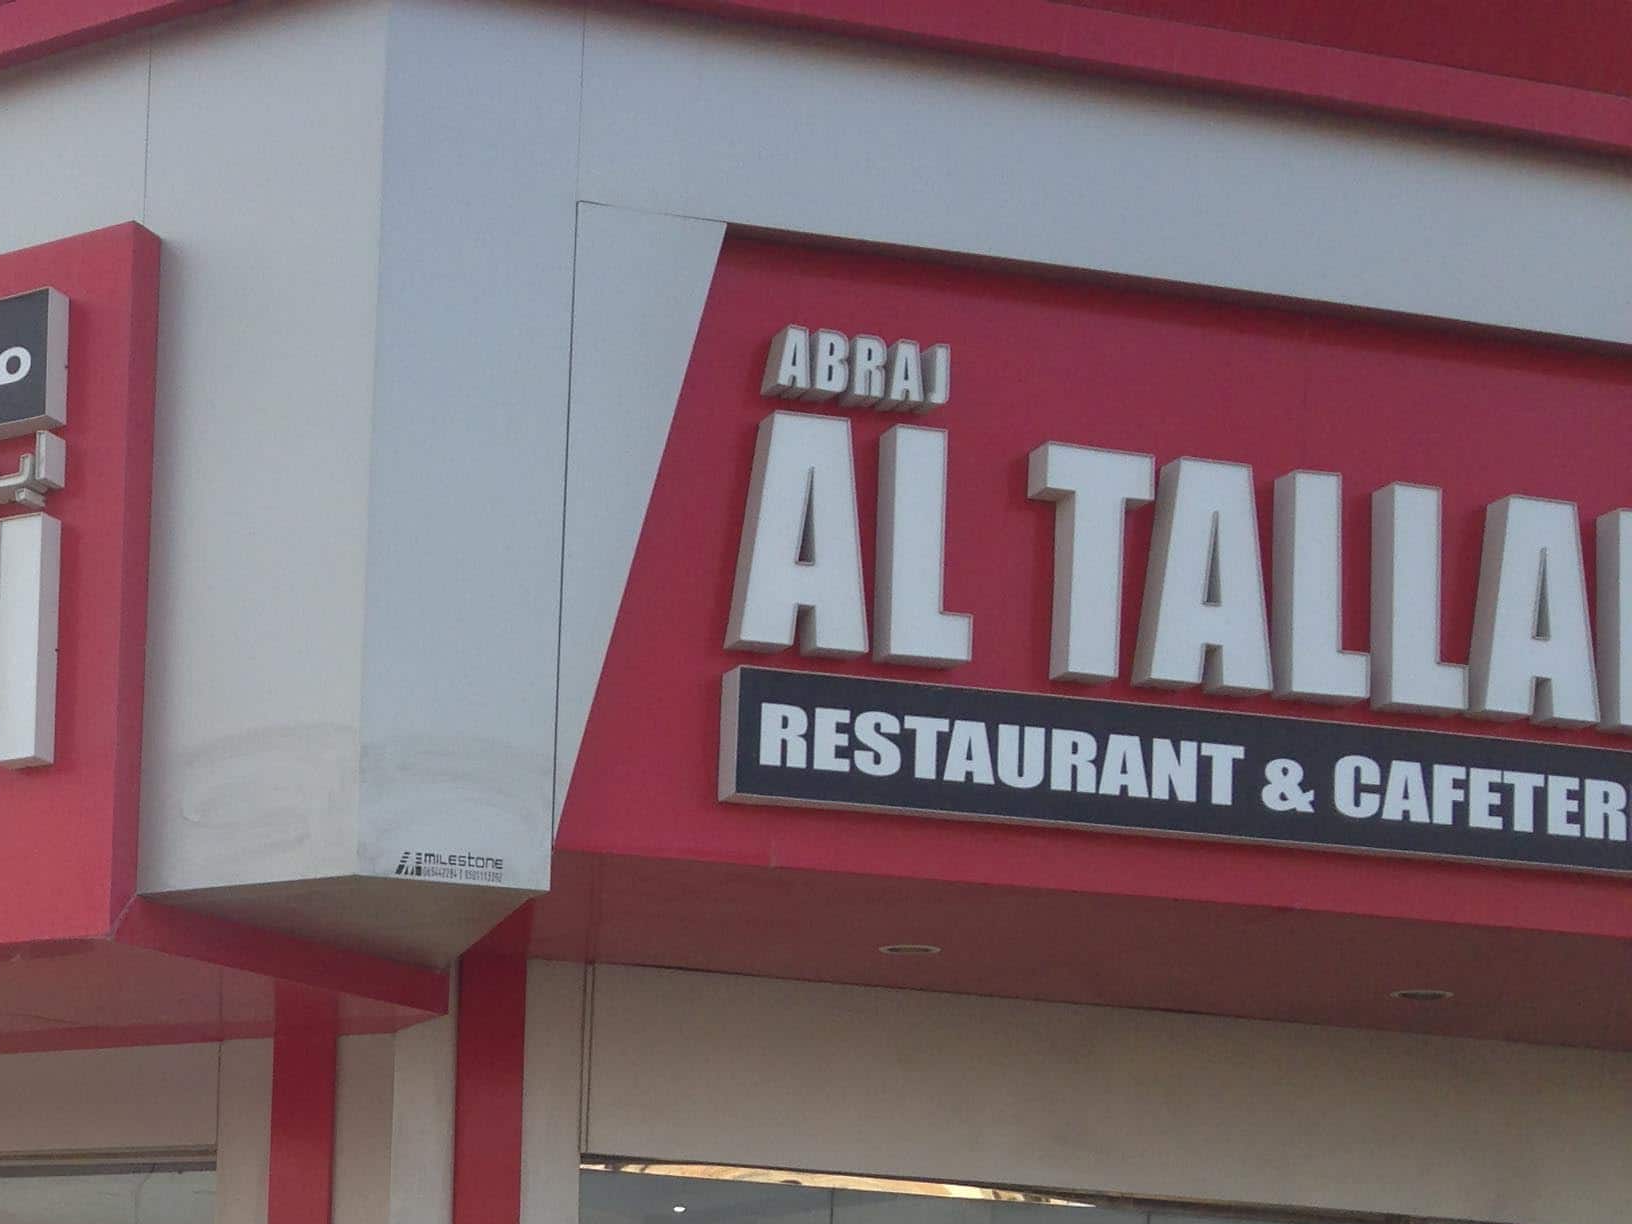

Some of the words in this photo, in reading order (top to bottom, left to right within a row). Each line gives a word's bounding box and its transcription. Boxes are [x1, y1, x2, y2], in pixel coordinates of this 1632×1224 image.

[760, 324, 951, 413] ABRAJ
[724, 410, 973, 668] AL
[1027, 440, 1632, 735] TALLA
[759, 701, 1245, 806] RESTAURANT
[1261, 759, 1316, 814] &
[1333, 754, 1632, 842] CAFETER
